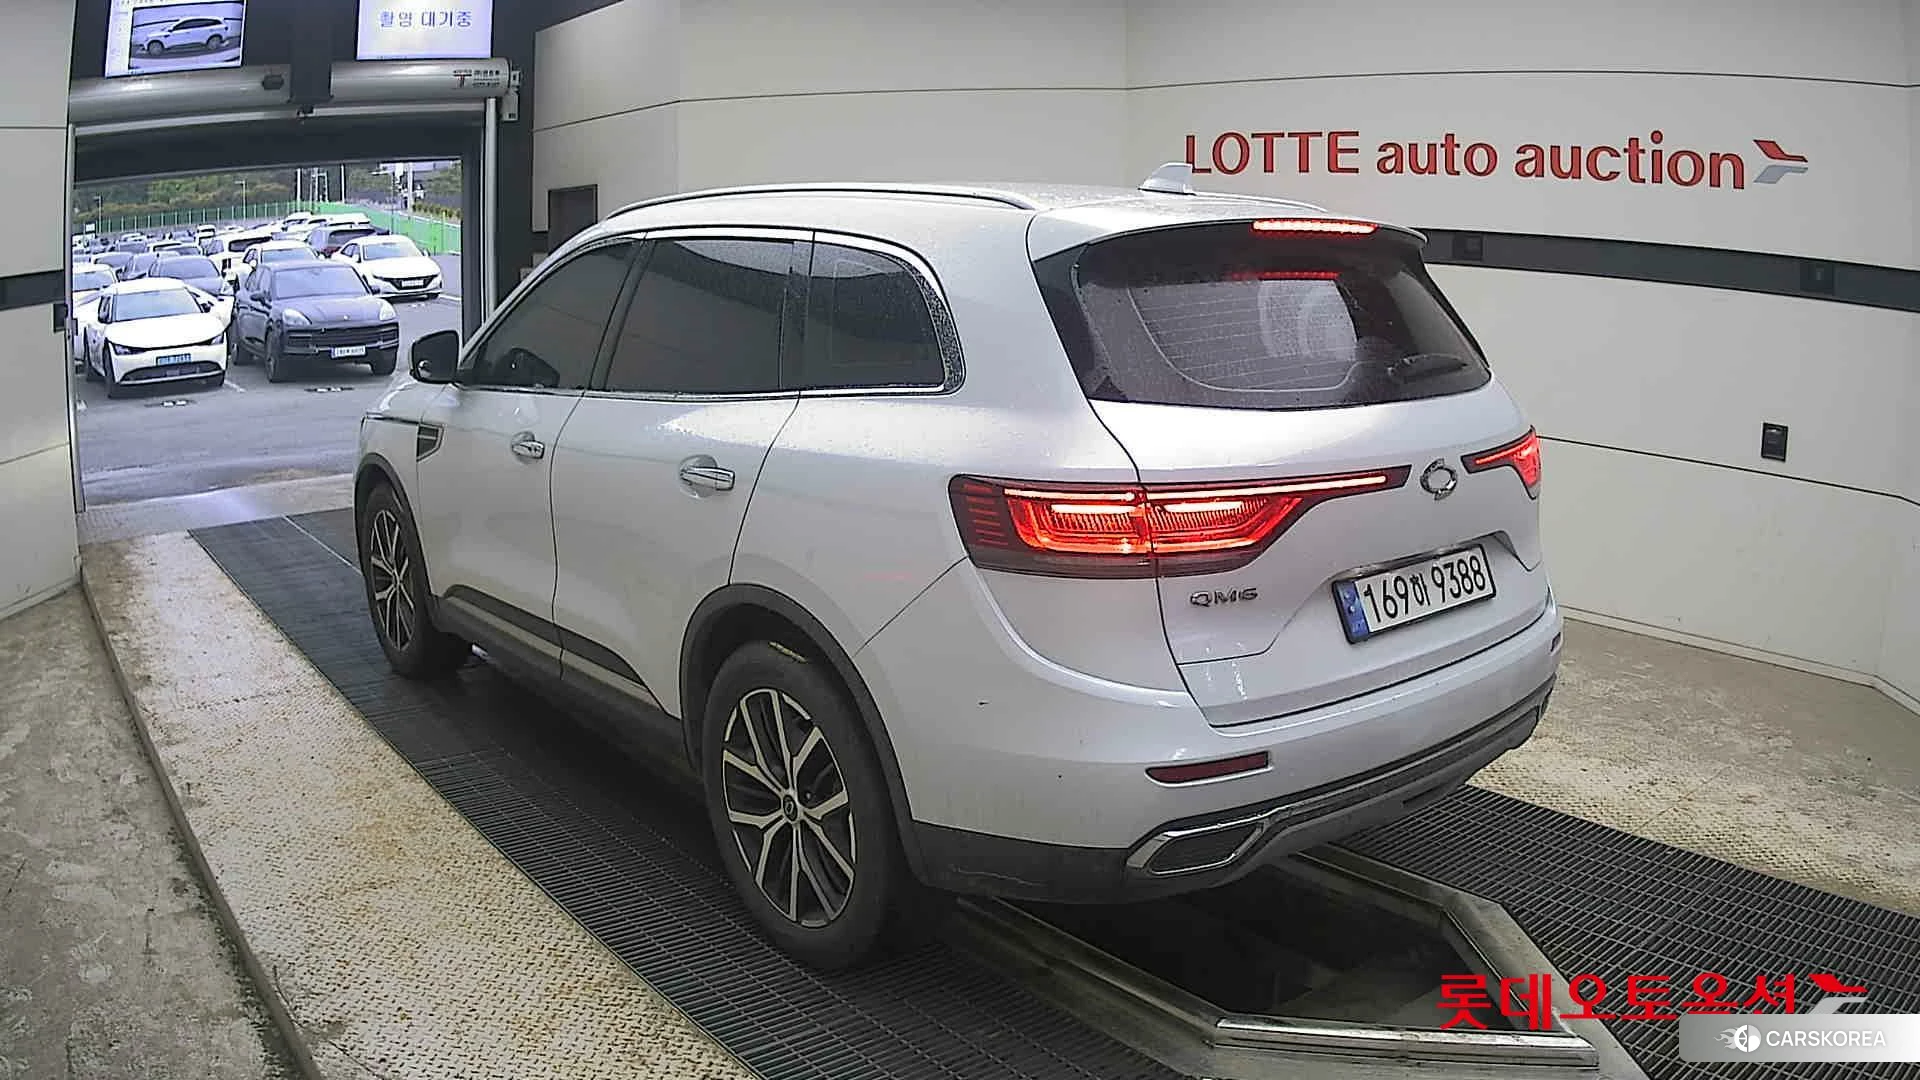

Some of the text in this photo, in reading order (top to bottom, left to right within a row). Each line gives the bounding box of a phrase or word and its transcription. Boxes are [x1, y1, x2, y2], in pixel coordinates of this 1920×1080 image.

[421, 11, 473, 28] 대기중
[1184, 129, 1745, 190] LOTTE auto auction
[1430, 554, 1487, 604] 9388
[1190, 587, 1259, 608] QM6
